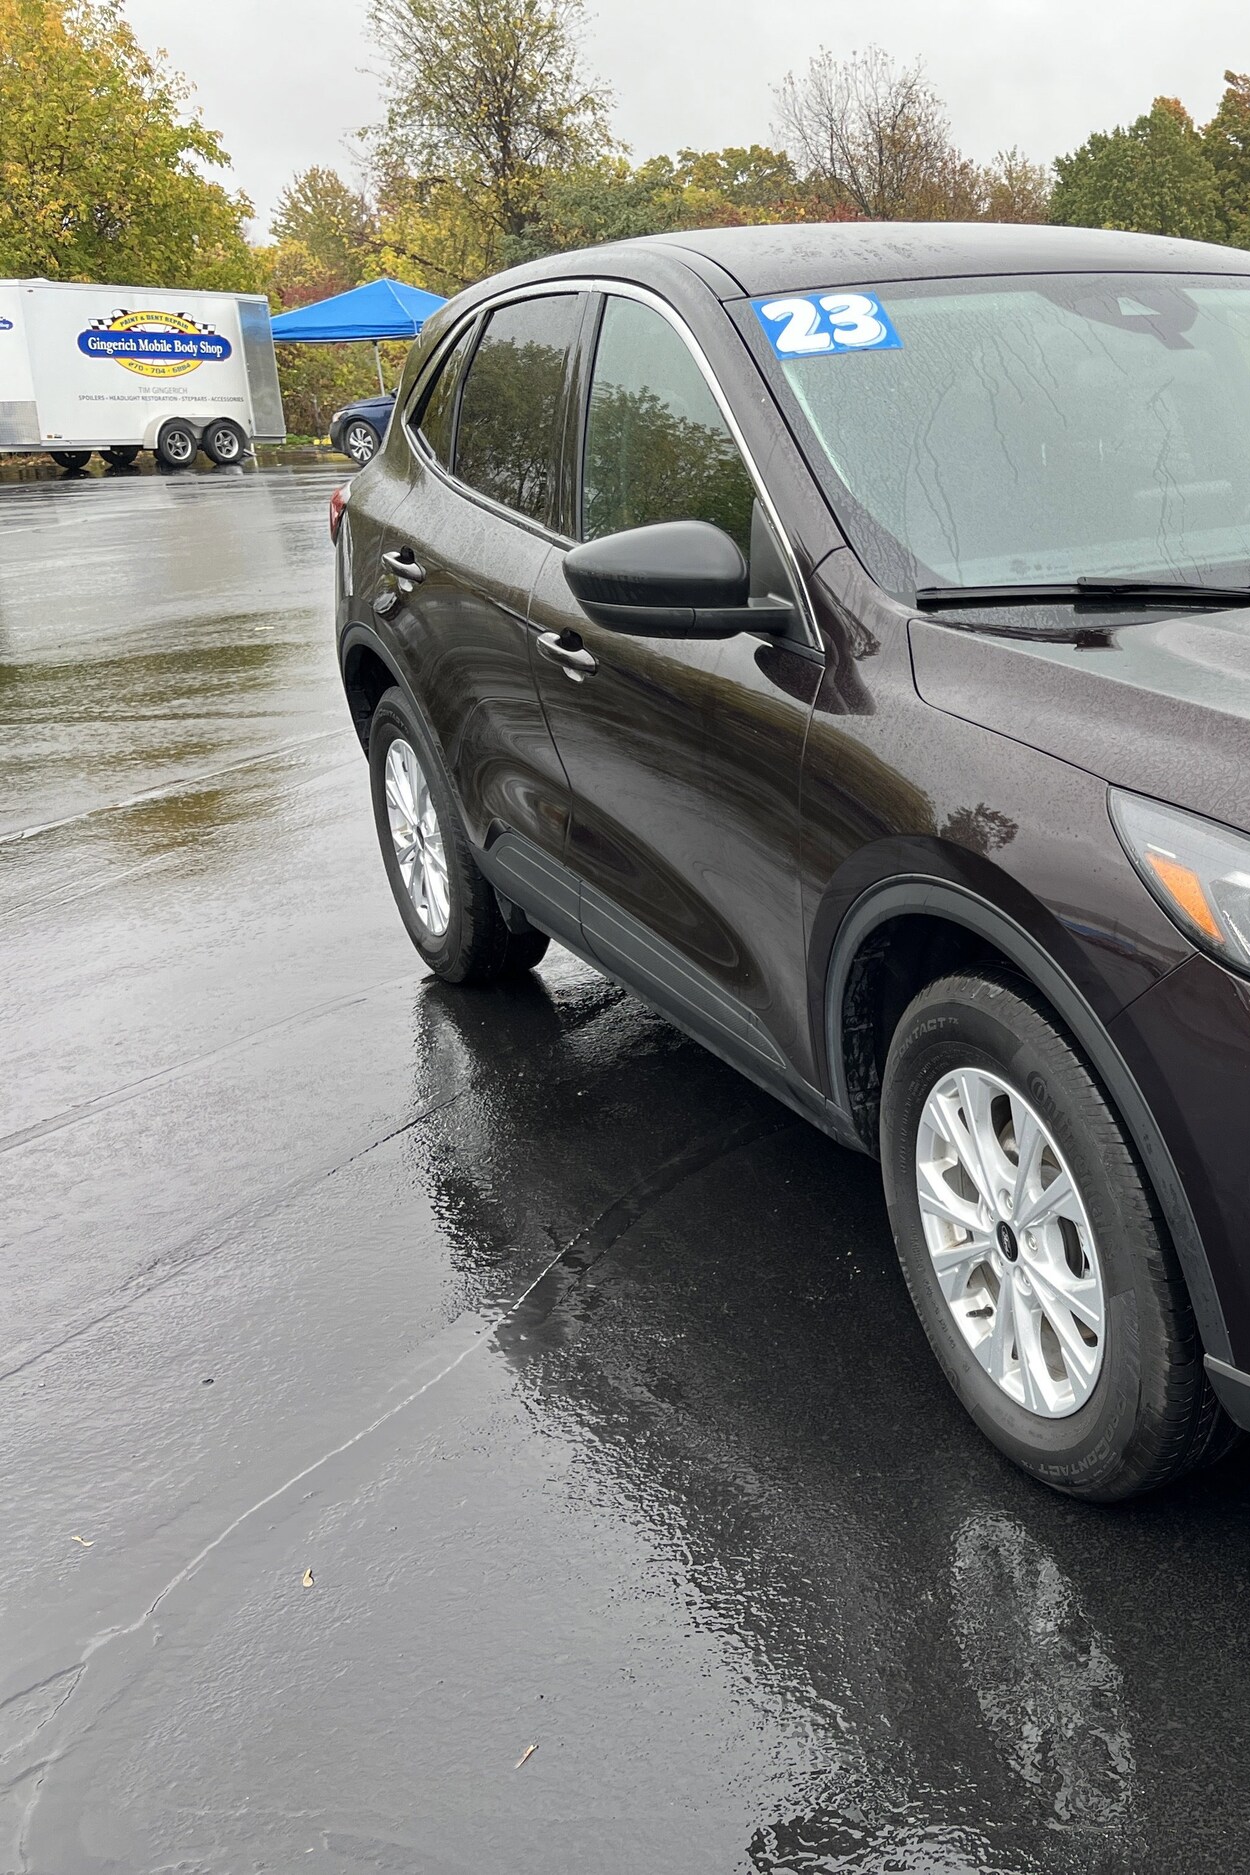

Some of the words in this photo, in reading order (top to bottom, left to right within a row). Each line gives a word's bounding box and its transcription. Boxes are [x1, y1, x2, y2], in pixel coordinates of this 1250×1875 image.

[120, 315, 139, 327] PAINT
[165, 316, 189, 330] REPAIR
[760, 294, 887, 354] 23
[88, 337, 137, 354] Gingerich
[138, 338, 172, 352] Mobile
[174, 340, 198, 356] Body
[200, 341, 223, 357] Shop
[138, 386, 151, 394] TIM
[152, 386, 188, 395] GINGERICH
